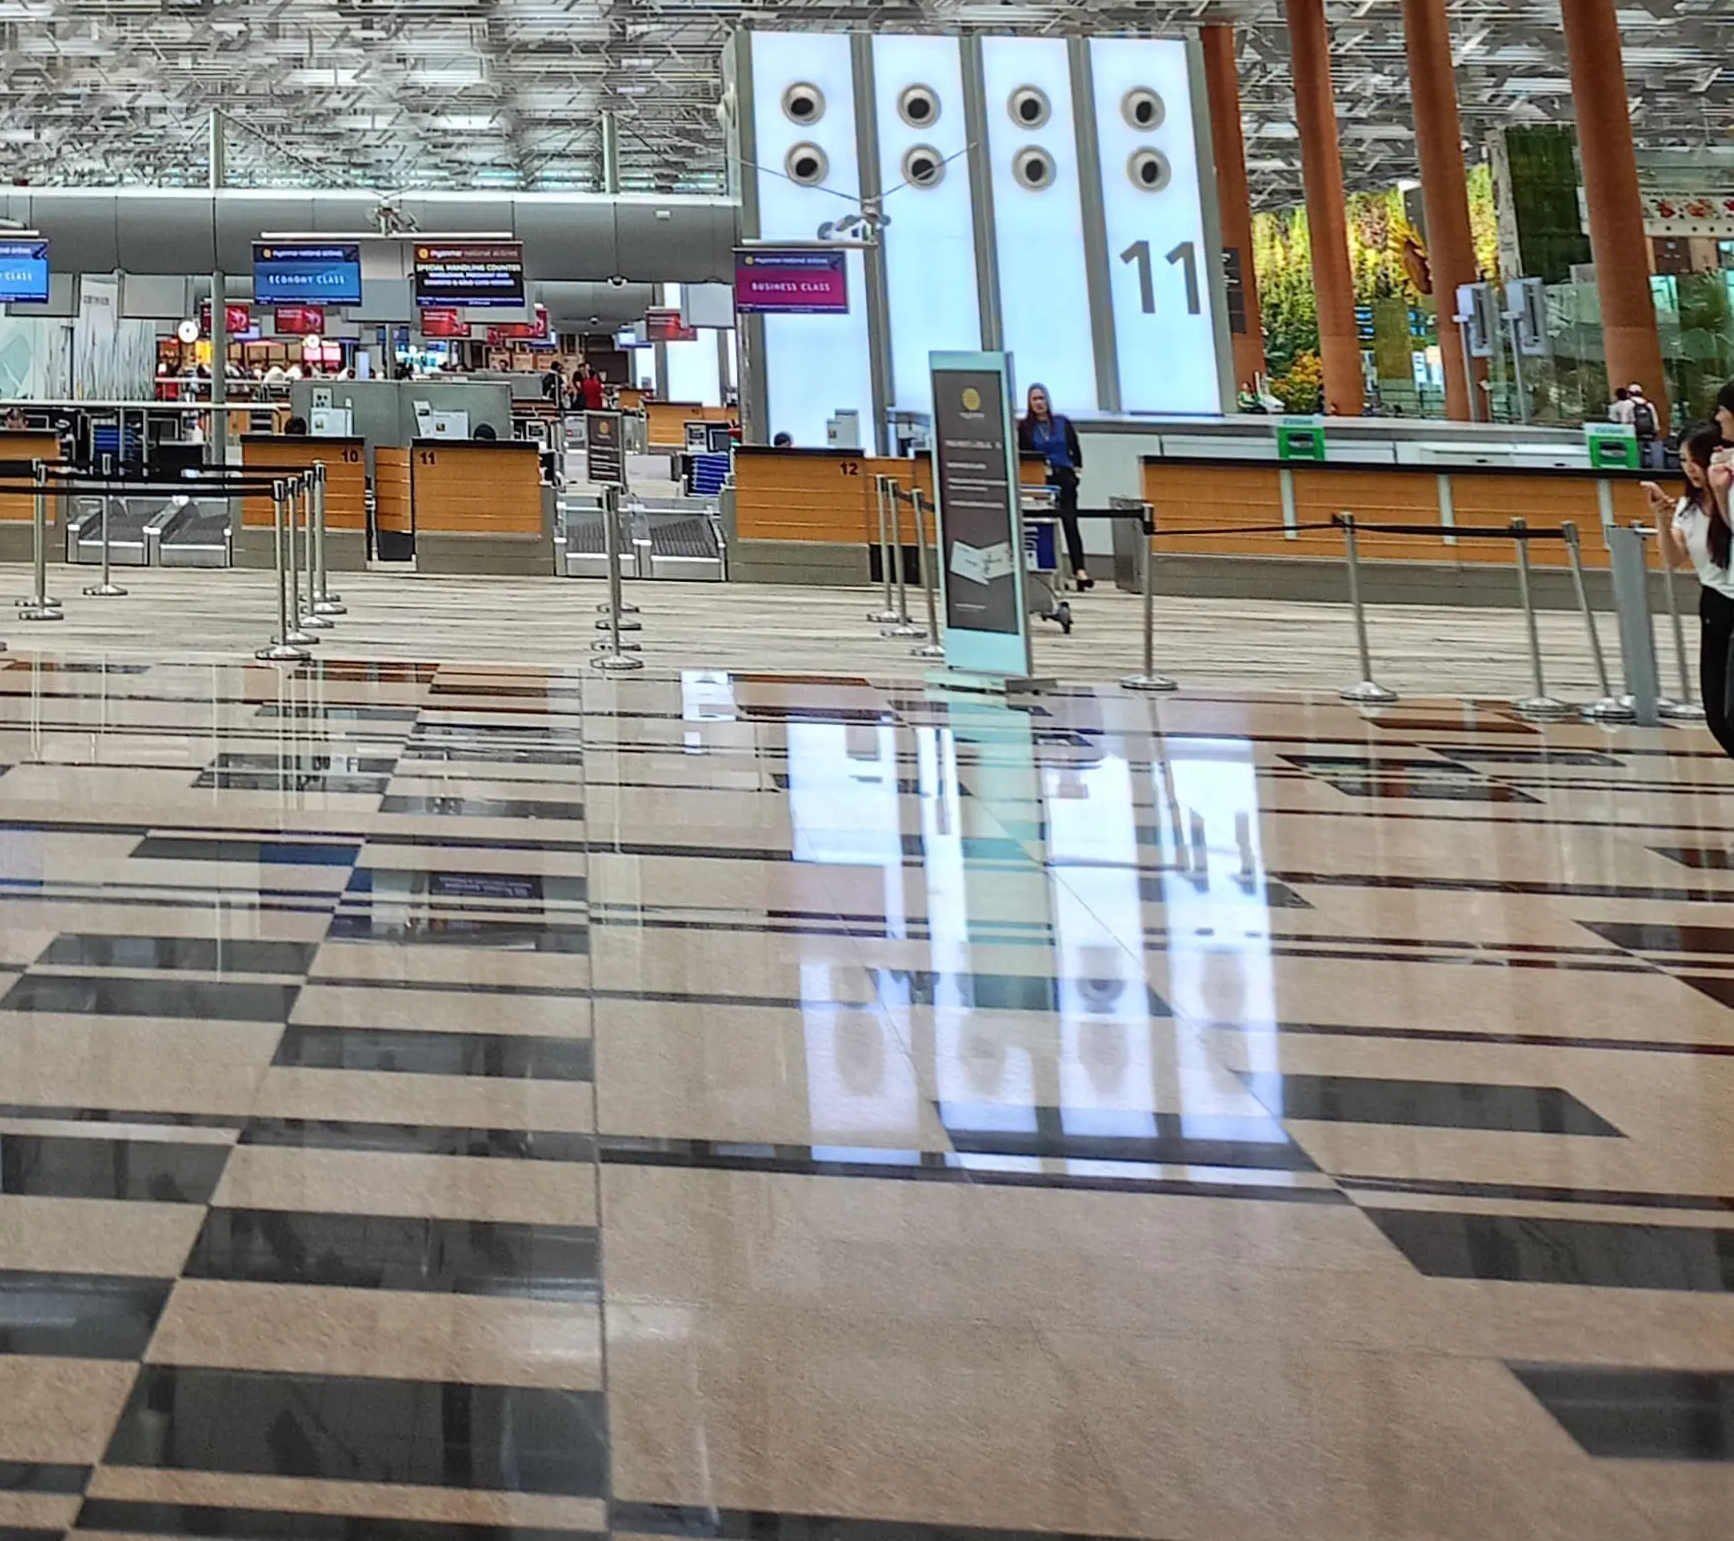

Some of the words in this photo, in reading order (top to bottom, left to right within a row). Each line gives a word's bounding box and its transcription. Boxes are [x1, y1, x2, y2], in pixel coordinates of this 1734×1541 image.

[5, 271, 33, 282] CLASS
[316, 274, 345, 285] CLASS
[1119, 240, 1201, 315] 11
[751, 281, 797, 291] BUSINESS
[800, 282, 830, 292] CLASS
[341, 449, 359, 463] 10
[420, 452, 435, 465] 11
[839, 461, 858, 476] 12
